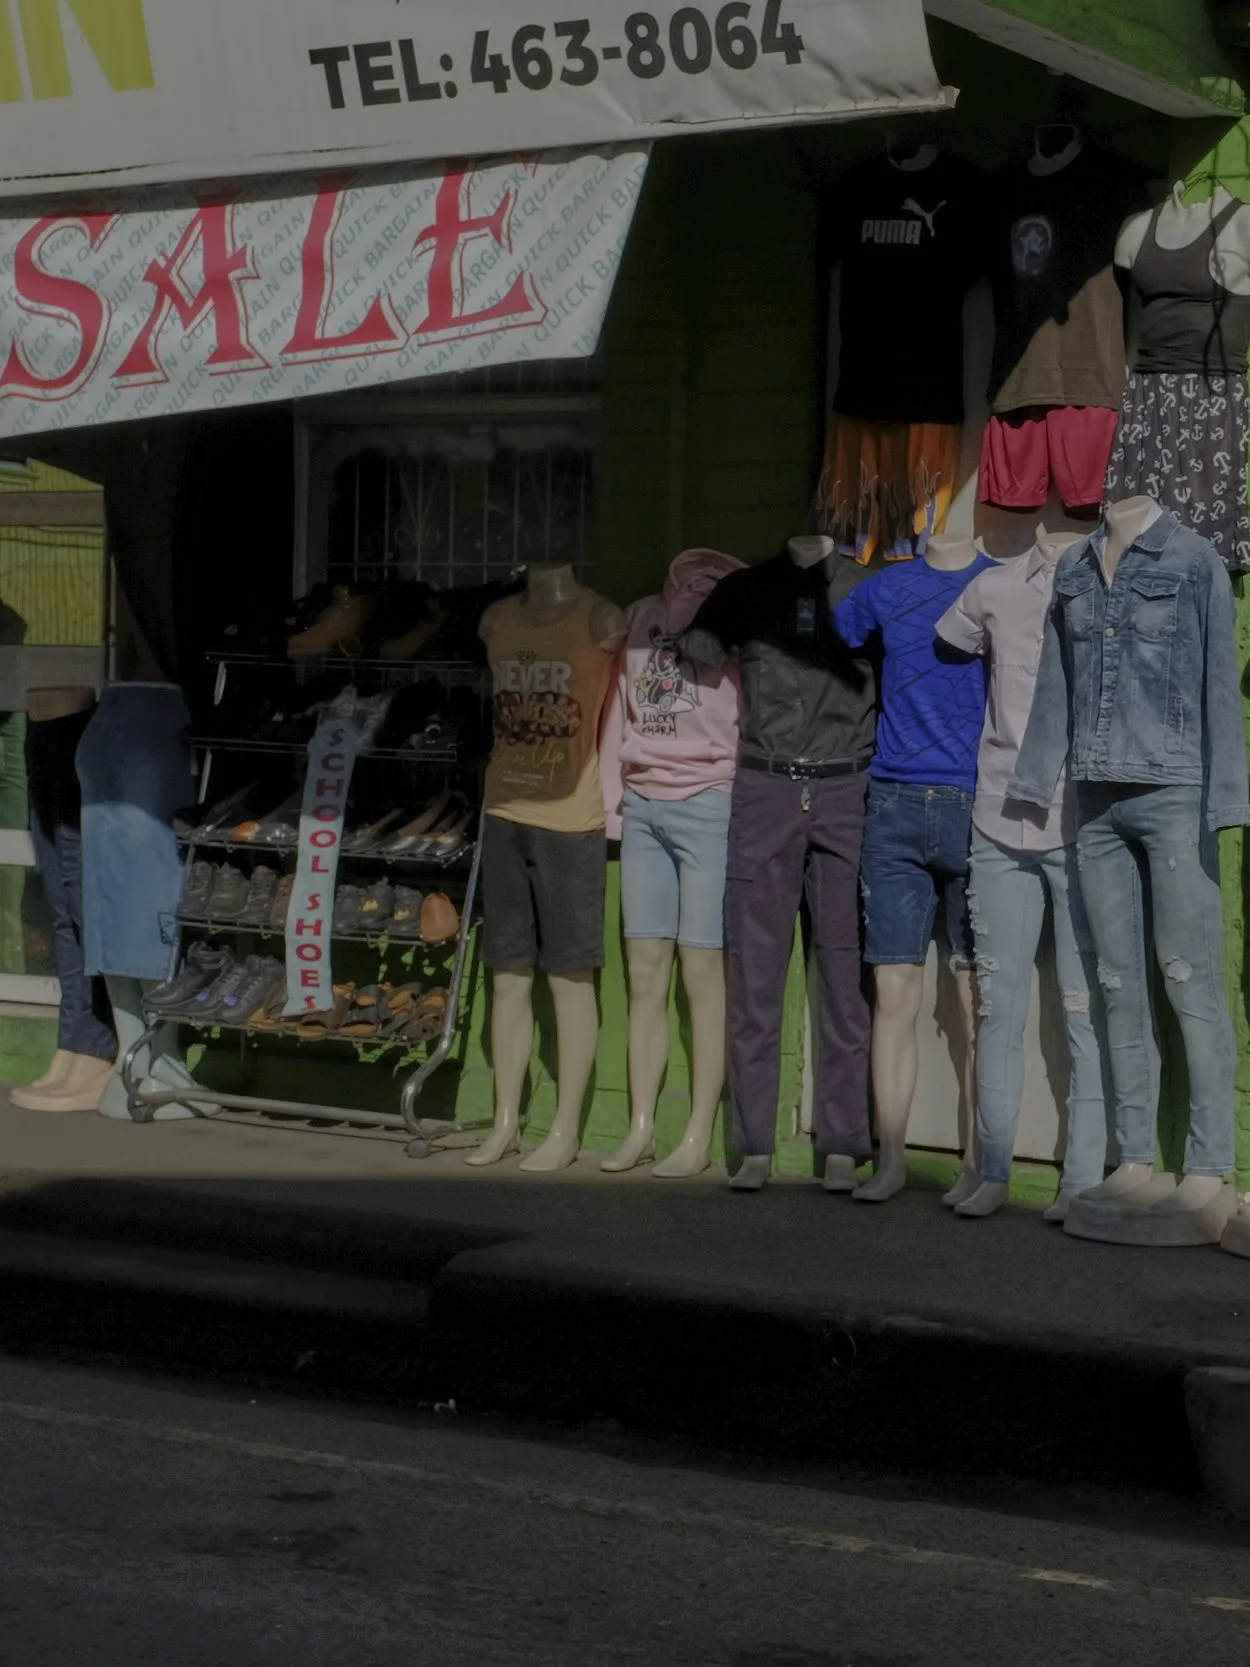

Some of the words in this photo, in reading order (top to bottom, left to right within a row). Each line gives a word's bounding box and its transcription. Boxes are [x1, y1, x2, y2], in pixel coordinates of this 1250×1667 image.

[309, 38, 458, 109] TEL:
[470, 0, 805, 93] 463-8064
[0, 157, 548, 401] SALE
[861, 219, 922, 245] PUMA
[491, 660, 572, 694] NEVER
[309, 728, 344, 873] SCHOOL
[295, 893, 322, 1012] SHOES
